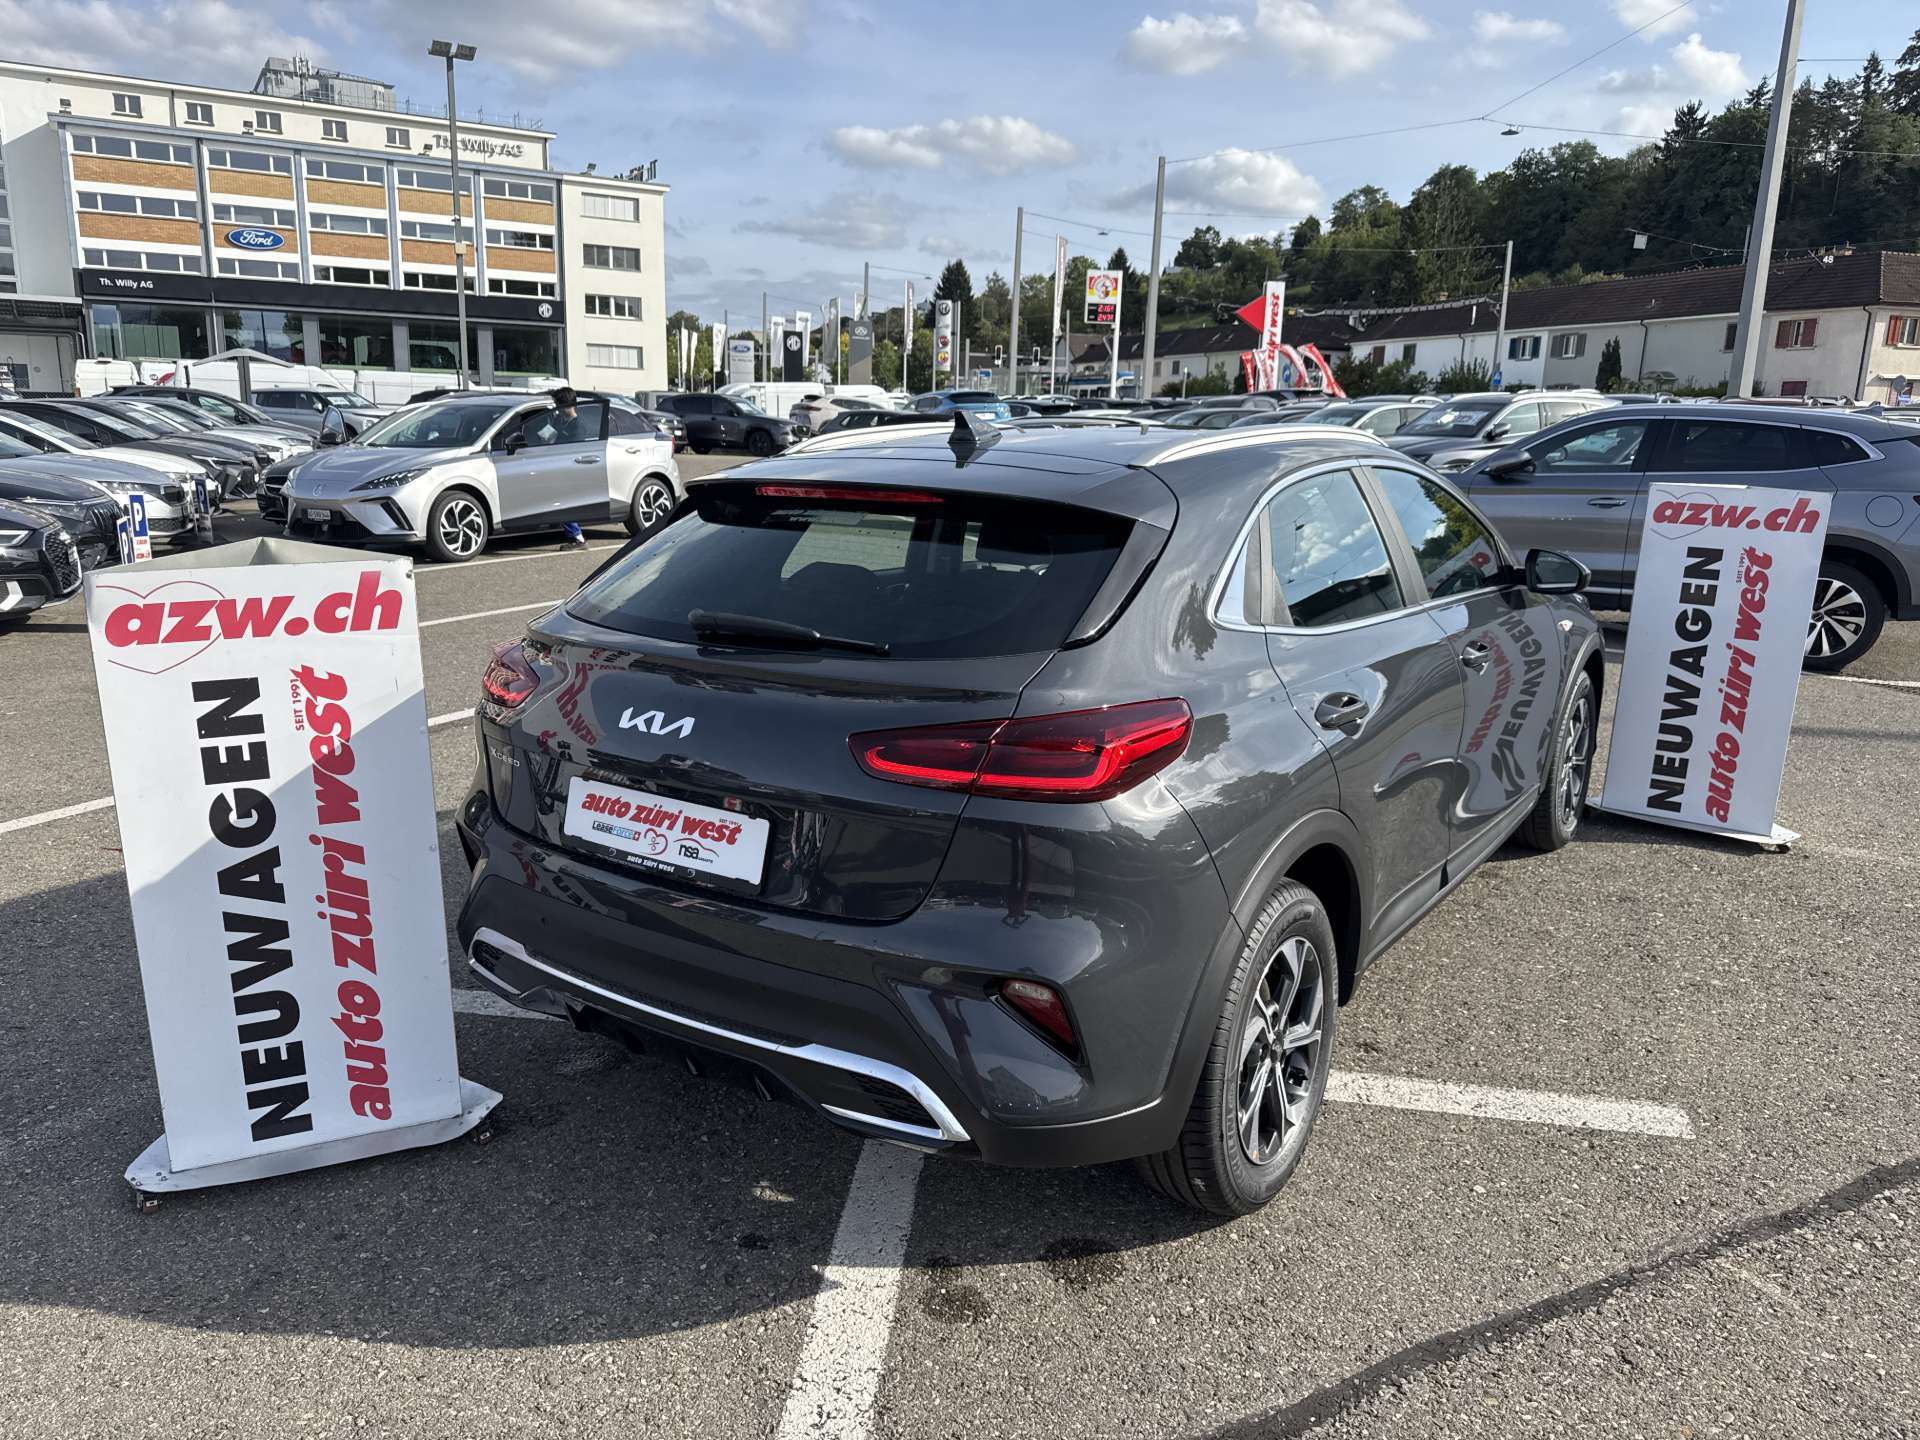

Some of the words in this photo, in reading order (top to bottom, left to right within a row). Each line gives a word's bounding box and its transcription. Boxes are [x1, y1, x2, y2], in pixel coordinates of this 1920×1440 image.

[239, 230, 273, 246] Ford
[1823, 256, 1834, 264] 48
[99, 278, 114, 287] Th.
[115, 279, 138, 289] Willy
[140, 281, 154, 289] AG
[1269, 291, 1281, 328] west
[787, 335, 801, 351] MG
[133, 502, 143, 532] P
[1652, 498, 1821, 534] azw.ch
[104, 570, 403, 648] azw.ch
[1734, 545, 1773, 642] west
[290, 678, 302, 704] 1991
[1646, 546, 1725, 813] NEUWAGEN
[1718, 642, 1757, 734] züri
[294, 708, 305, 731] SEIT
[619, 706, 696, 740] KIA
[290, 664, 361, 825] west
[490, 746, 520, 767] XCEED
[1706, 732, 1741, 824] auto
[581, 792, 632, 818] auto
[630, 803, 683, 831] züri
[681, 813, 743, 846] west
[626, 854, 643, 865] auto
[658, 863, 676, 874] west
[678, 844, 700, 860] nsa
[191, 676, 314, 1143] NEUWAGEN
[308, 833, 378, 976] züri
[330, 980, 393, 1121] auto
